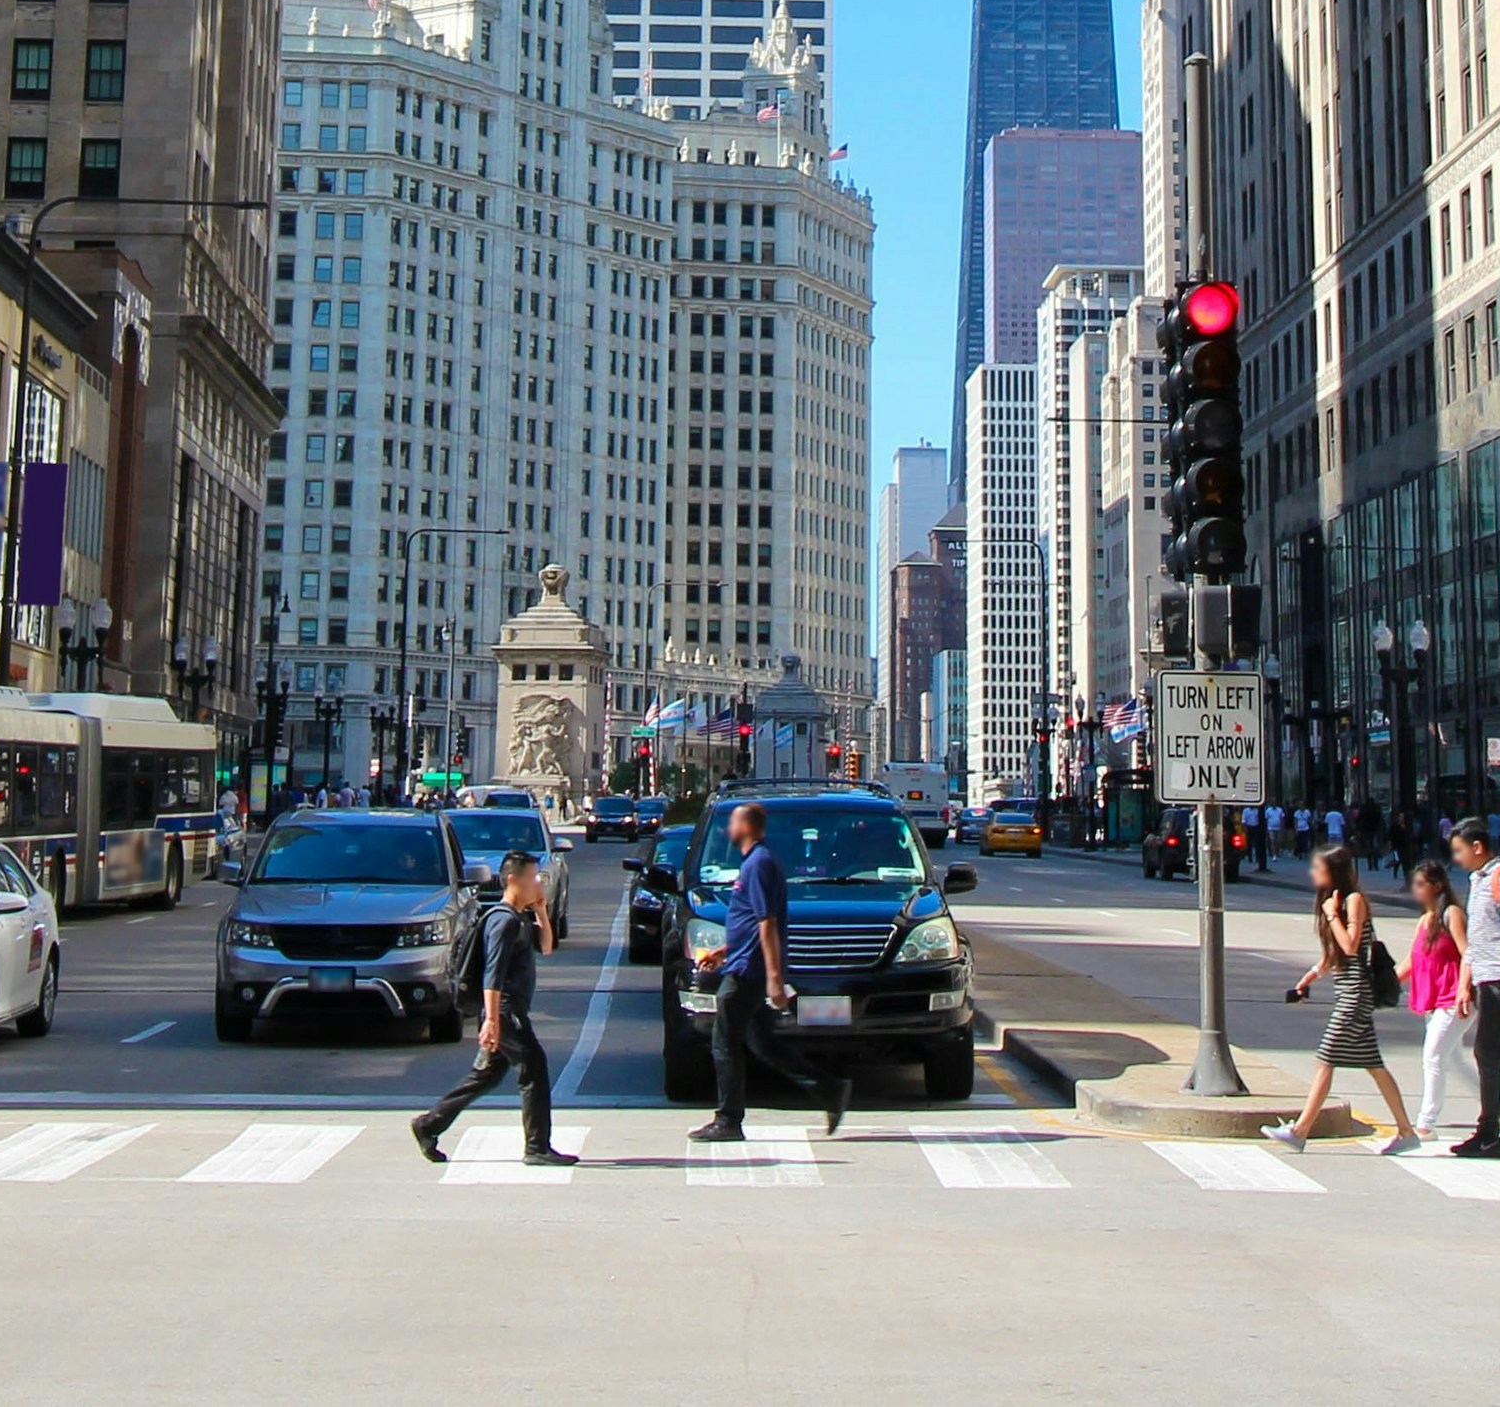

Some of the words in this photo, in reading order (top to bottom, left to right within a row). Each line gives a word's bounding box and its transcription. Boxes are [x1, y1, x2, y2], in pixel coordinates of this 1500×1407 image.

[1167, 685, 1208, 709] TURN
[1216, 686, 1255, 710] LEFT
[1200, 713, 1222, 731] ON
[1167, 735, 1200, 759] LEFT
[1206, 736, 1255, 759] ARROW
